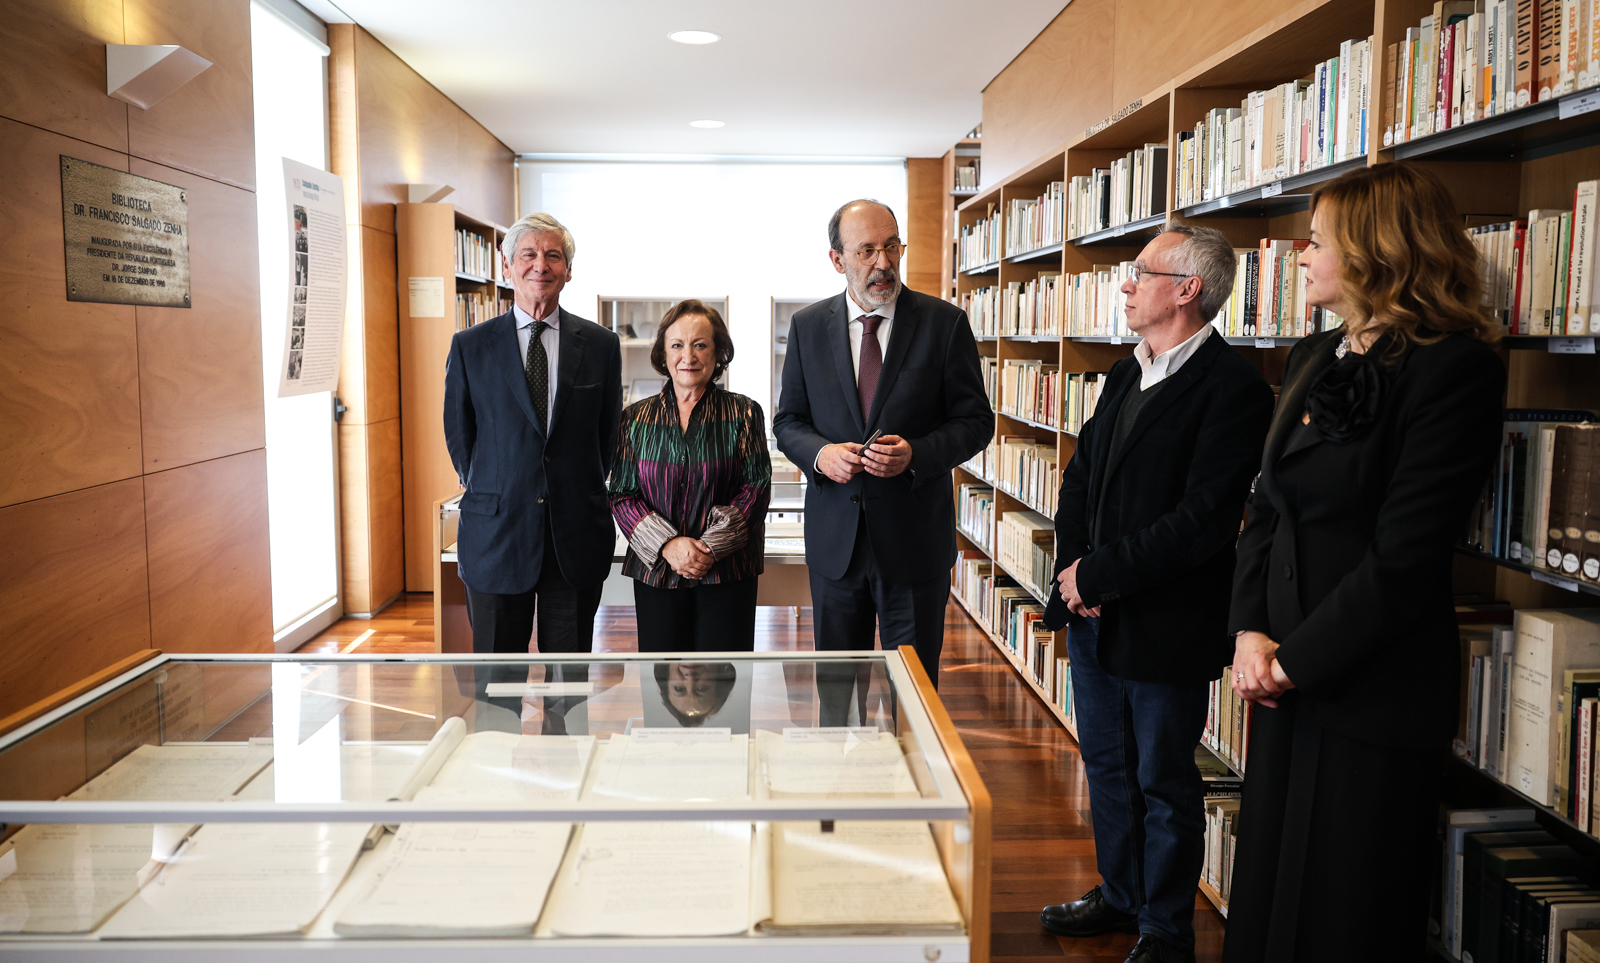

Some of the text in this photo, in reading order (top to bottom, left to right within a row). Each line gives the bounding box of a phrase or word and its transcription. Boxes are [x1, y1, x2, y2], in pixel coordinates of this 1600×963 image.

[1568, 30, 1577, 73] MARX
[1517, 60, 1530, 71] O
[1540, 56, 1552, 66] O
[1112, 106, 1128, 124] SALGADO
[1129, 98, 1143, 114] ZENHA
[112, 193, 152, 212] BIBLIOTECA
[74, 204, 182, 235] DR. FRANCISCO SALGADO ZENHA
[91, 236, 121, 248] INAUGURADA
[122, 241, 132, 249] POR
[133, 242, 142, 251] SUA
[87, 248, 117, 259] PRESIDENTE
[150, 256, 176, 267] PORTUGUESA
[112, 263, 157, 276] DR. JORGE SAMPAIO
[102, 273, 110, 282] EM
[118, 275, 124, 284] DE
[125, 276, 148, 286] DEZEMBRO
[1528, 414, 1595, 422] PENSADORES
[1581, 750, 1587, 759] do
